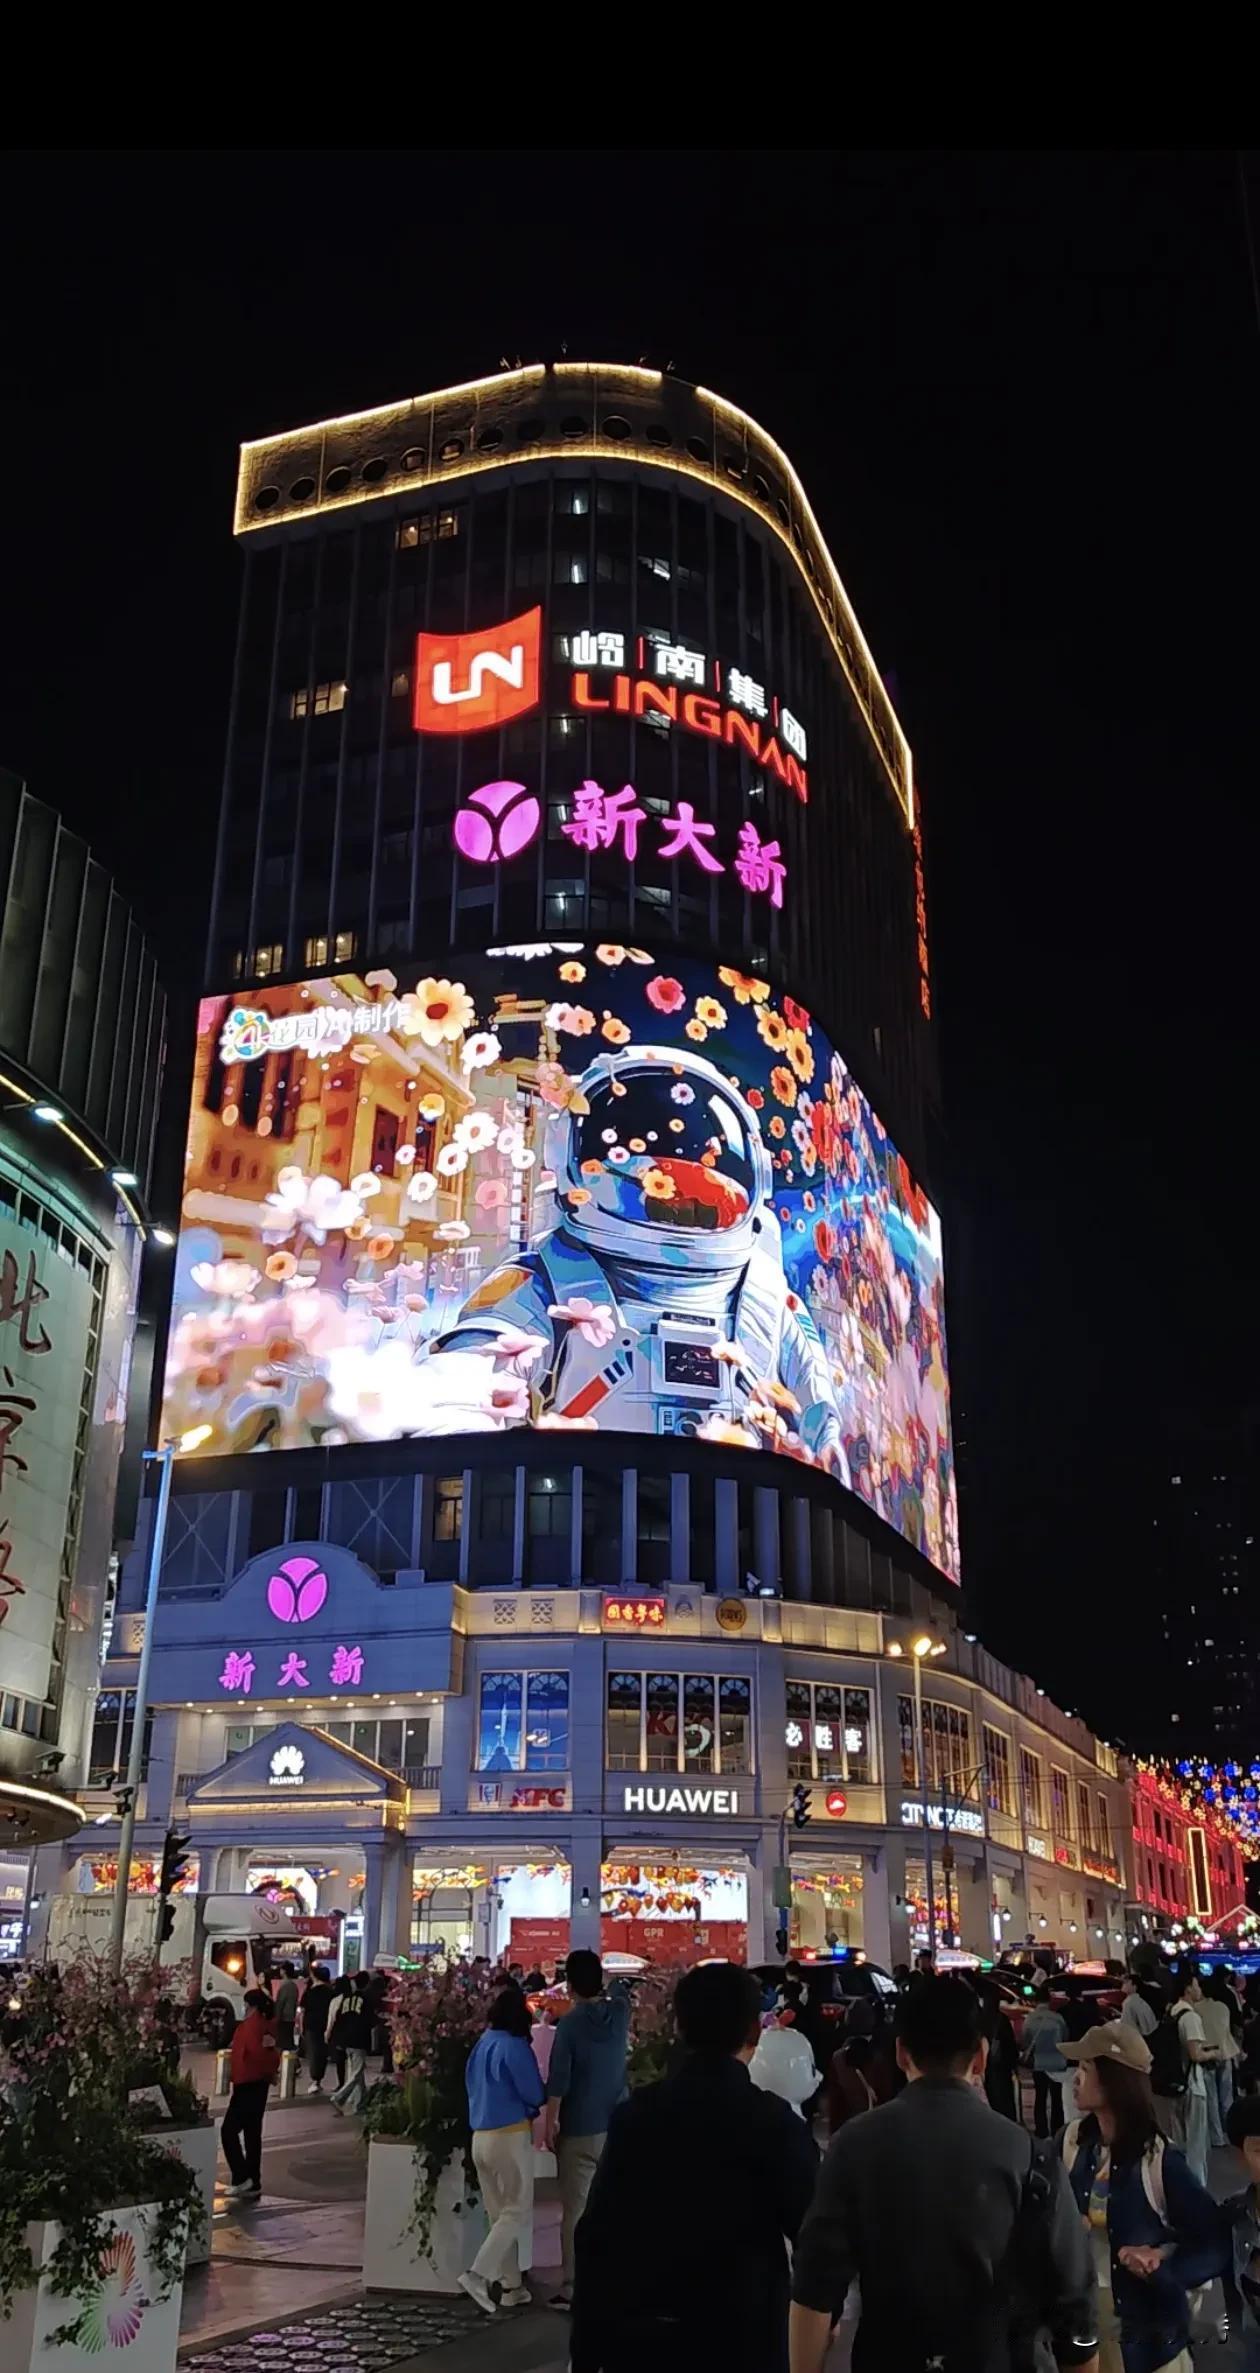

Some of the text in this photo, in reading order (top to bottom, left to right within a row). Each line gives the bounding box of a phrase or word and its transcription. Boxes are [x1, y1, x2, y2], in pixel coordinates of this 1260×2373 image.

[572, 630, 807, 761] 岭南集团
[573, 672, 808, 803] LINGNAN
[561, 780, 787, 908] 新大新
[218, 1645, 364, 1694] 新大新
[785, 1721, 863, 1753] 必胜客
[269, 1775, 304, 1785] HUAWEI
[624, 1787, 738, 1814] HUAWEI
